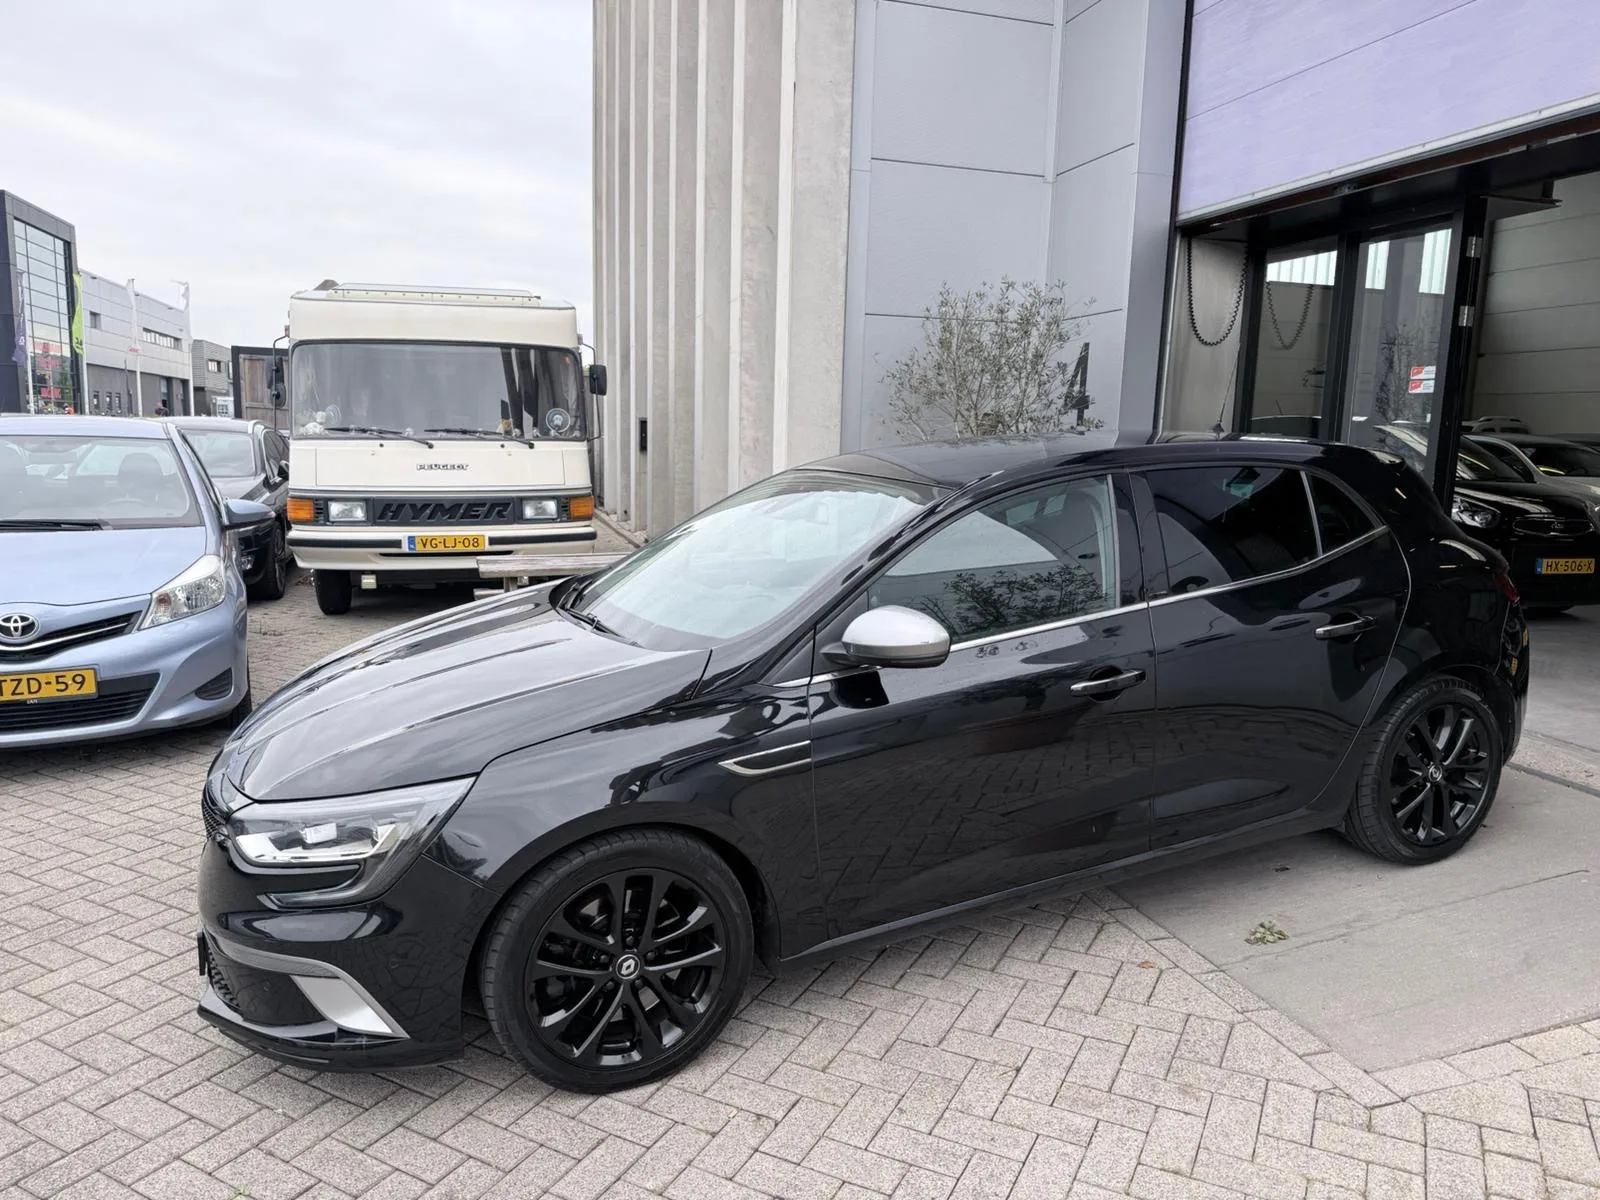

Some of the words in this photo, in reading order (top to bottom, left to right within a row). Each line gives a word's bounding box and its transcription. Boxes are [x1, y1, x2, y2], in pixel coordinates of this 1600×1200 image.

[1063, 342, 1090, 426] 4
[376, 502, 513, 522] HYMER
[420, 537, 480, 549] VG-LJ-08
[1545, 560, 1593, 572] HX-506-X
